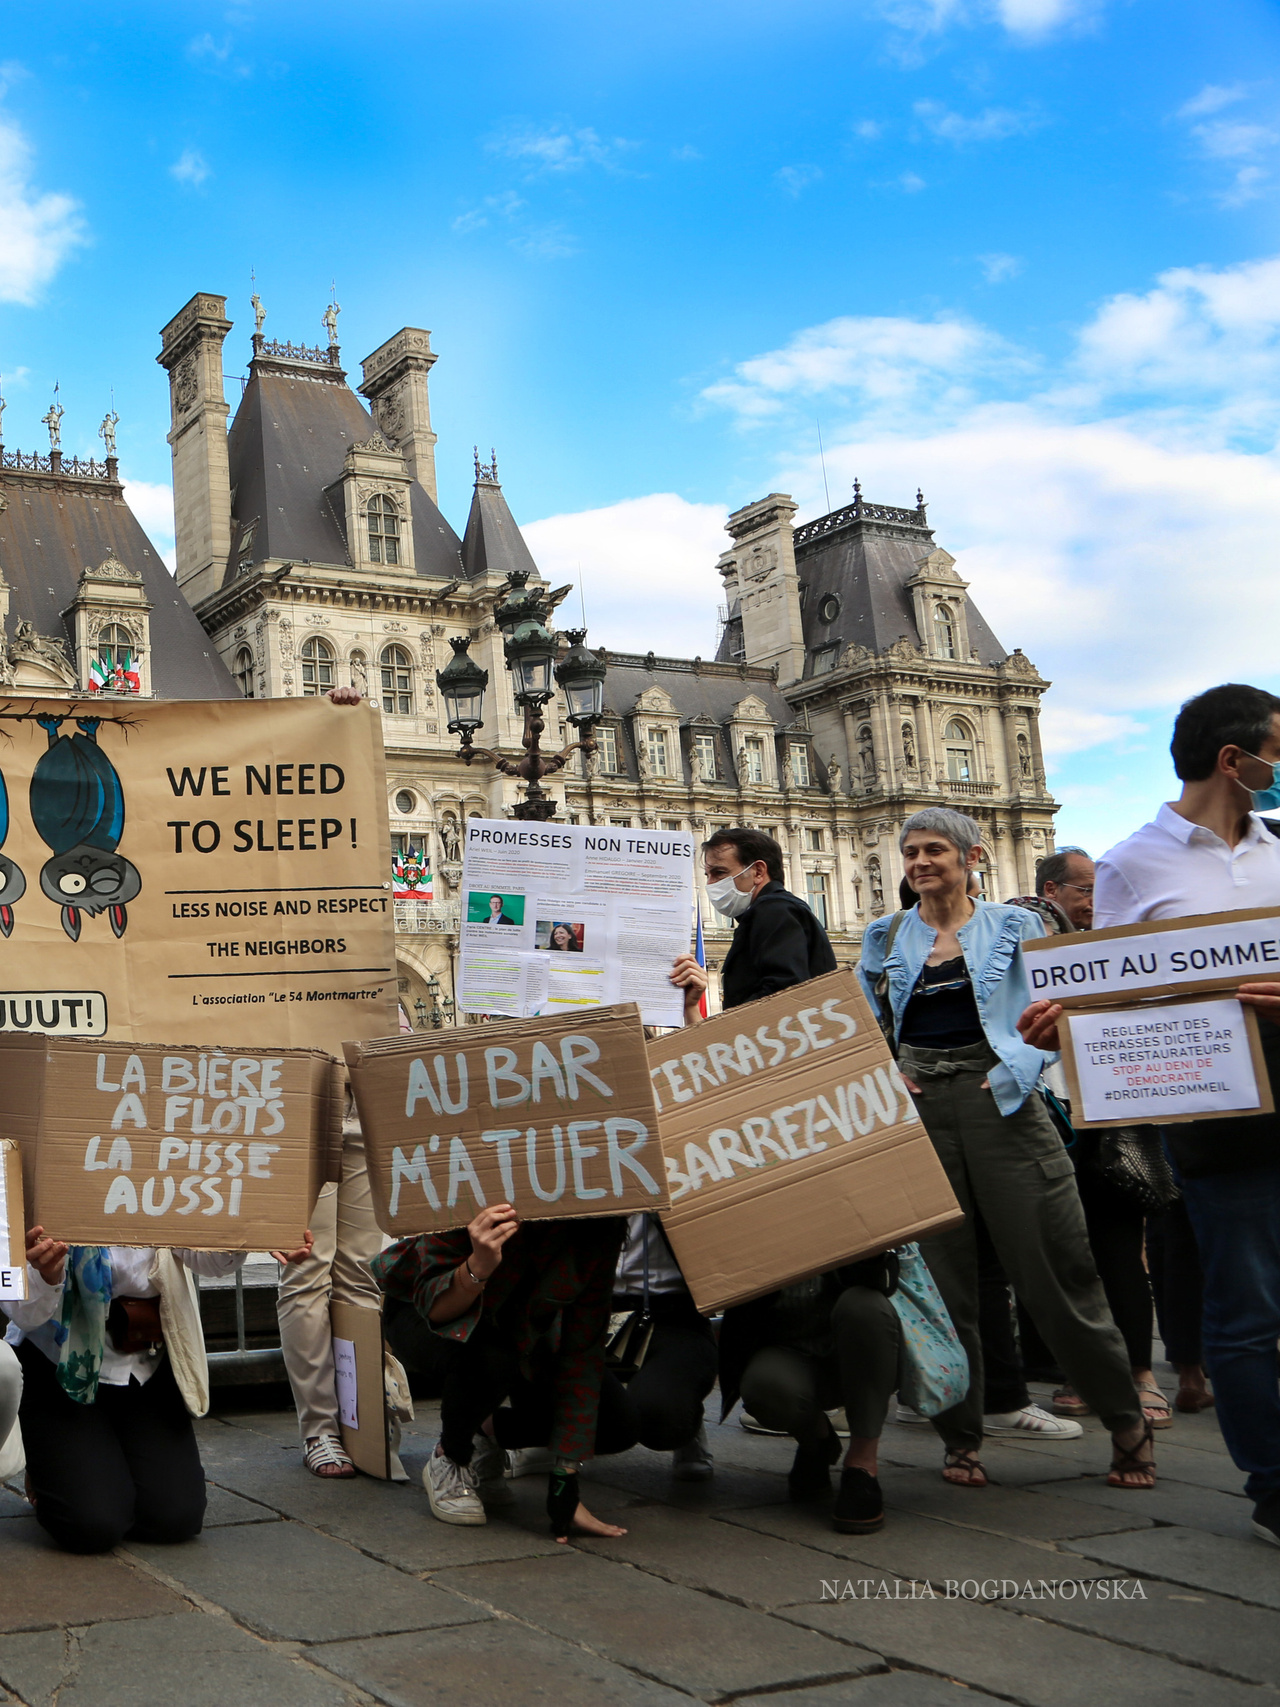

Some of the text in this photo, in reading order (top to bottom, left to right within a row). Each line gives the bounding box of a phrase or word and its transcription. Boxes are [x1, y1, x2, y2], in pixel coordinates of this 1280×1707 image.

[166, 763, 345, 798] WE NEED
[166, 819, 221, 854] TO
[470, 829, 691, 858] PROMESSES NON TENUES
[641, 872, 668, 880] Septembre
[171, 902, 212, 919] LESS
[215, 900, 268, 917] NOISE
[273, 898, 312, 915] AND
[316, 897, 388, 915] RESPECT
[206, 938, 347, 958] THE NEIGHBORS
[1031, 938, 1280, 989] DROIT AU SOMME
[289, 990, 303, 1003] 54
[1102, 1018, 1211, 1038] REGLEMENT DES
[1084, 1029, 1233, 1053] TERRASSES DICTE PAR
[1090, 1042, 1232, 1066] LES RESTAURATEURS
[96, 1053, 146, 1094] LA
[406, 1035, 614, 1118] AU BAR
[1112, 1058, 1213, 1076] STOP AU DENI DE
[1126, 1071, 1202, 1087] DEMOCRATIE
[1104, 1082, 1231, 1101] #DROITAUSOMMEIL
[111, 1093, 286, 1136] A FLOTS
[83, 1136, 281, 1178] LA PISSE
[103, 1174, 243, 1217] AUSSI
